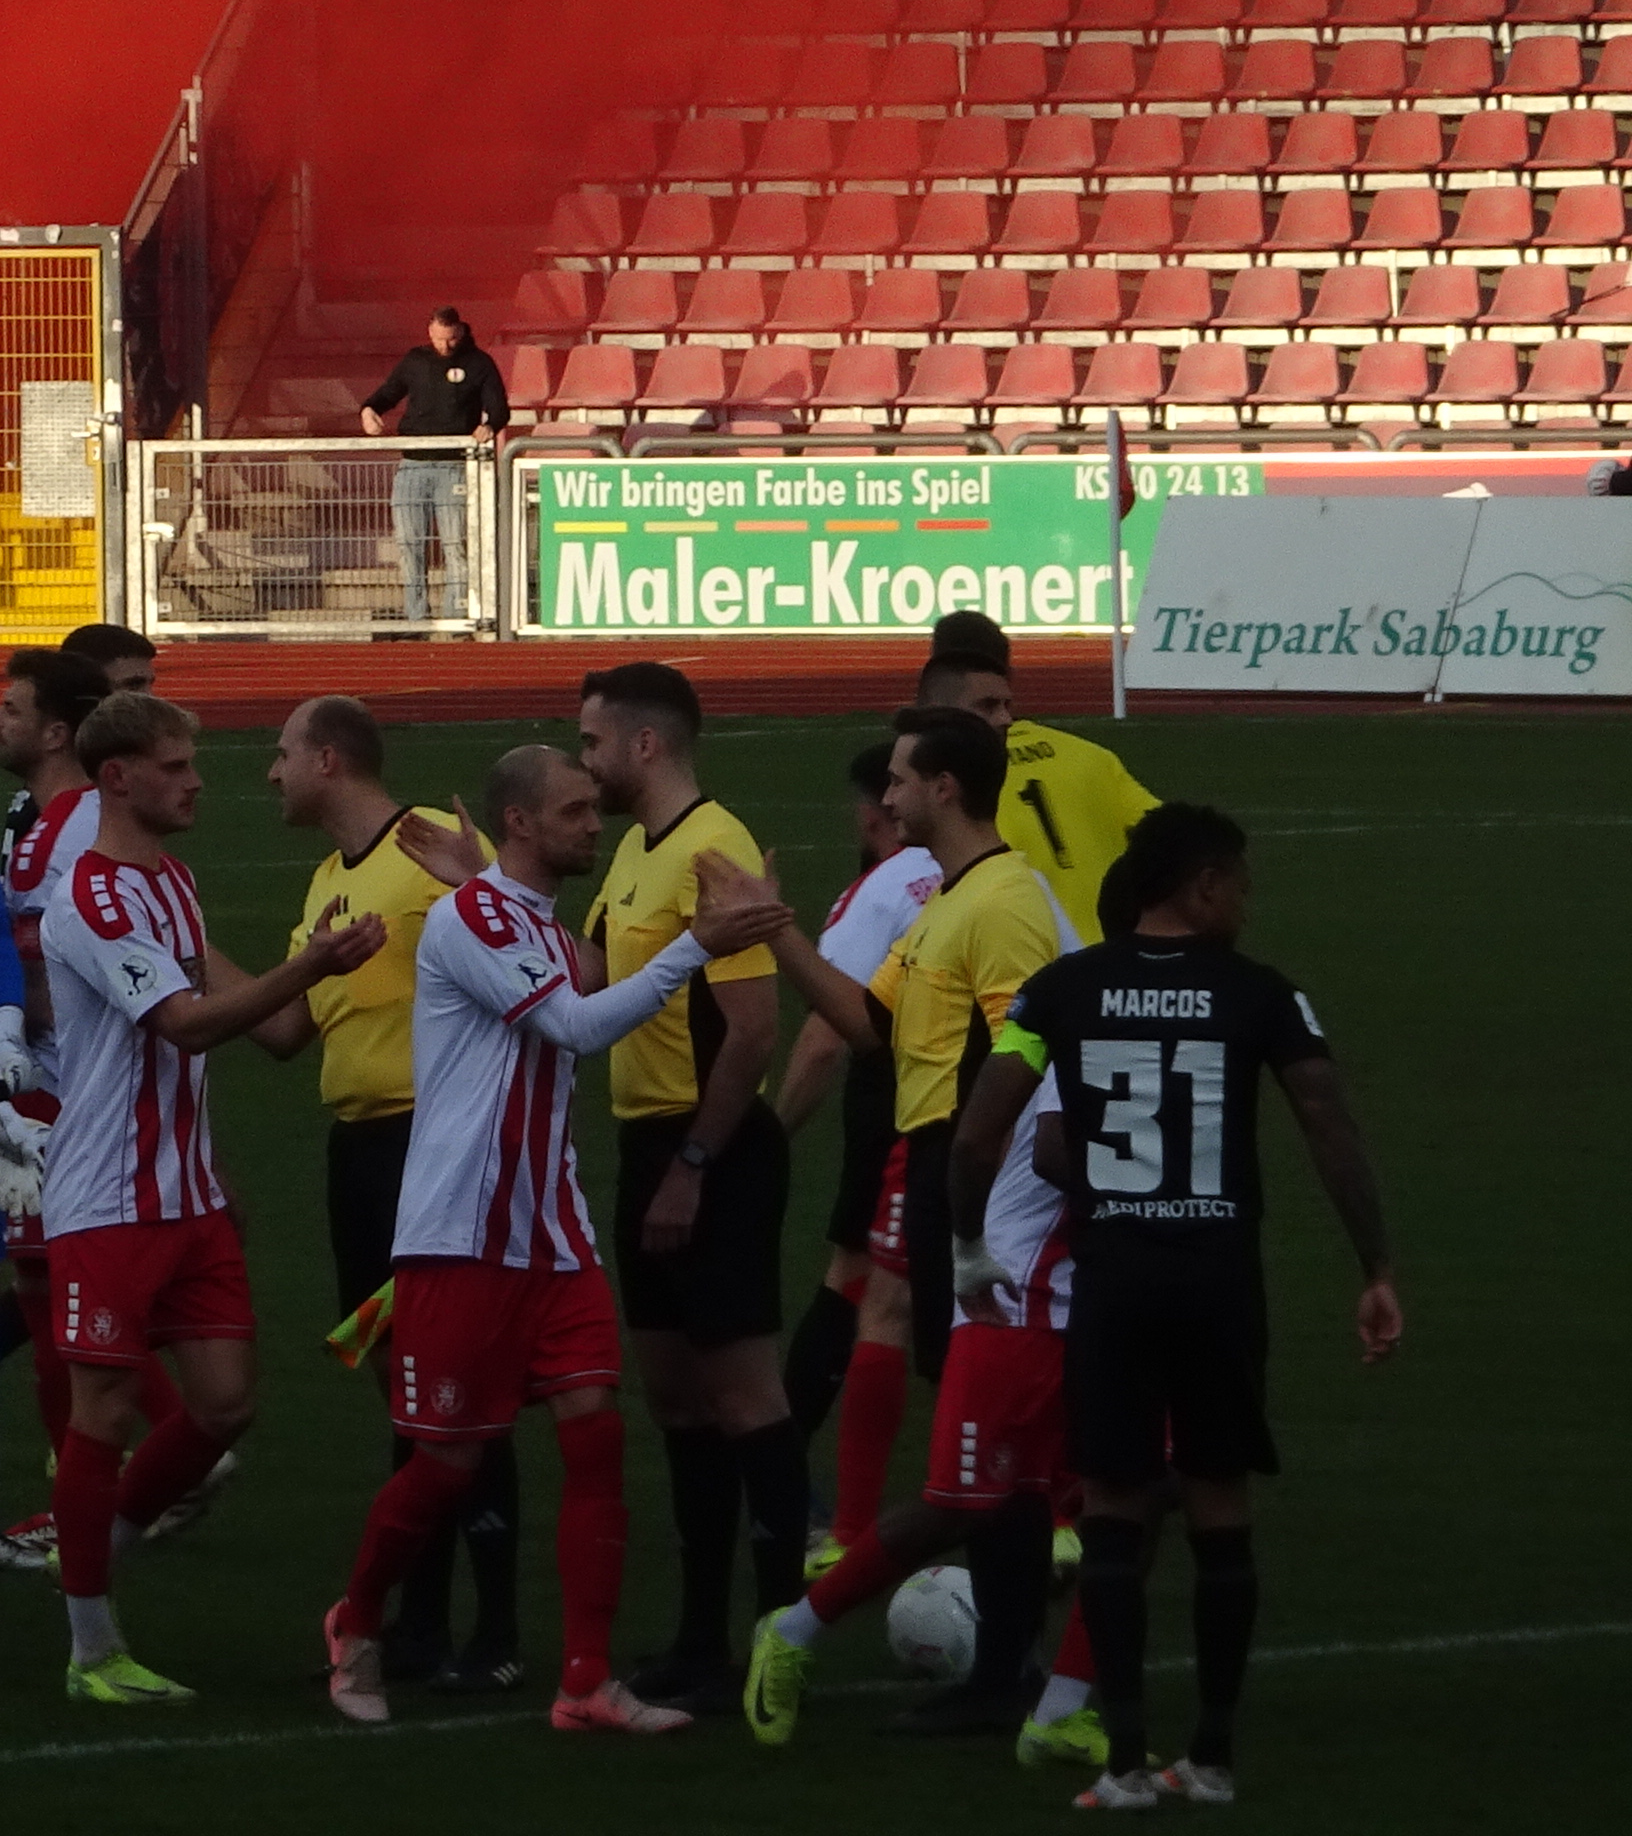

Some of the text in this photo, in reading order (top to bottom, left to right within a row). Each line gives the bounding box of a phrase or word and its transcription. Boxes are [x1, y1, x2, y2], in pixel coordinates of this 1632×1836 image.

[553, 466, 991, 517] Wir bringen Farbe ins Spiel
[1075, 465, 1111, 500] KS
[1167, 465, 1203, 495] 24
[1216, 465, 1250, 495] 13
[554, 537, 1134, 625] Maler-Kroenert
[1154, 606, 1606, 675] Tierpark Sababurg
[1018, 779, 1074, 869] 1
[1101, 988, 1212, 1020] MARCOS
[1080, 1040, 1226, 1196] 31
